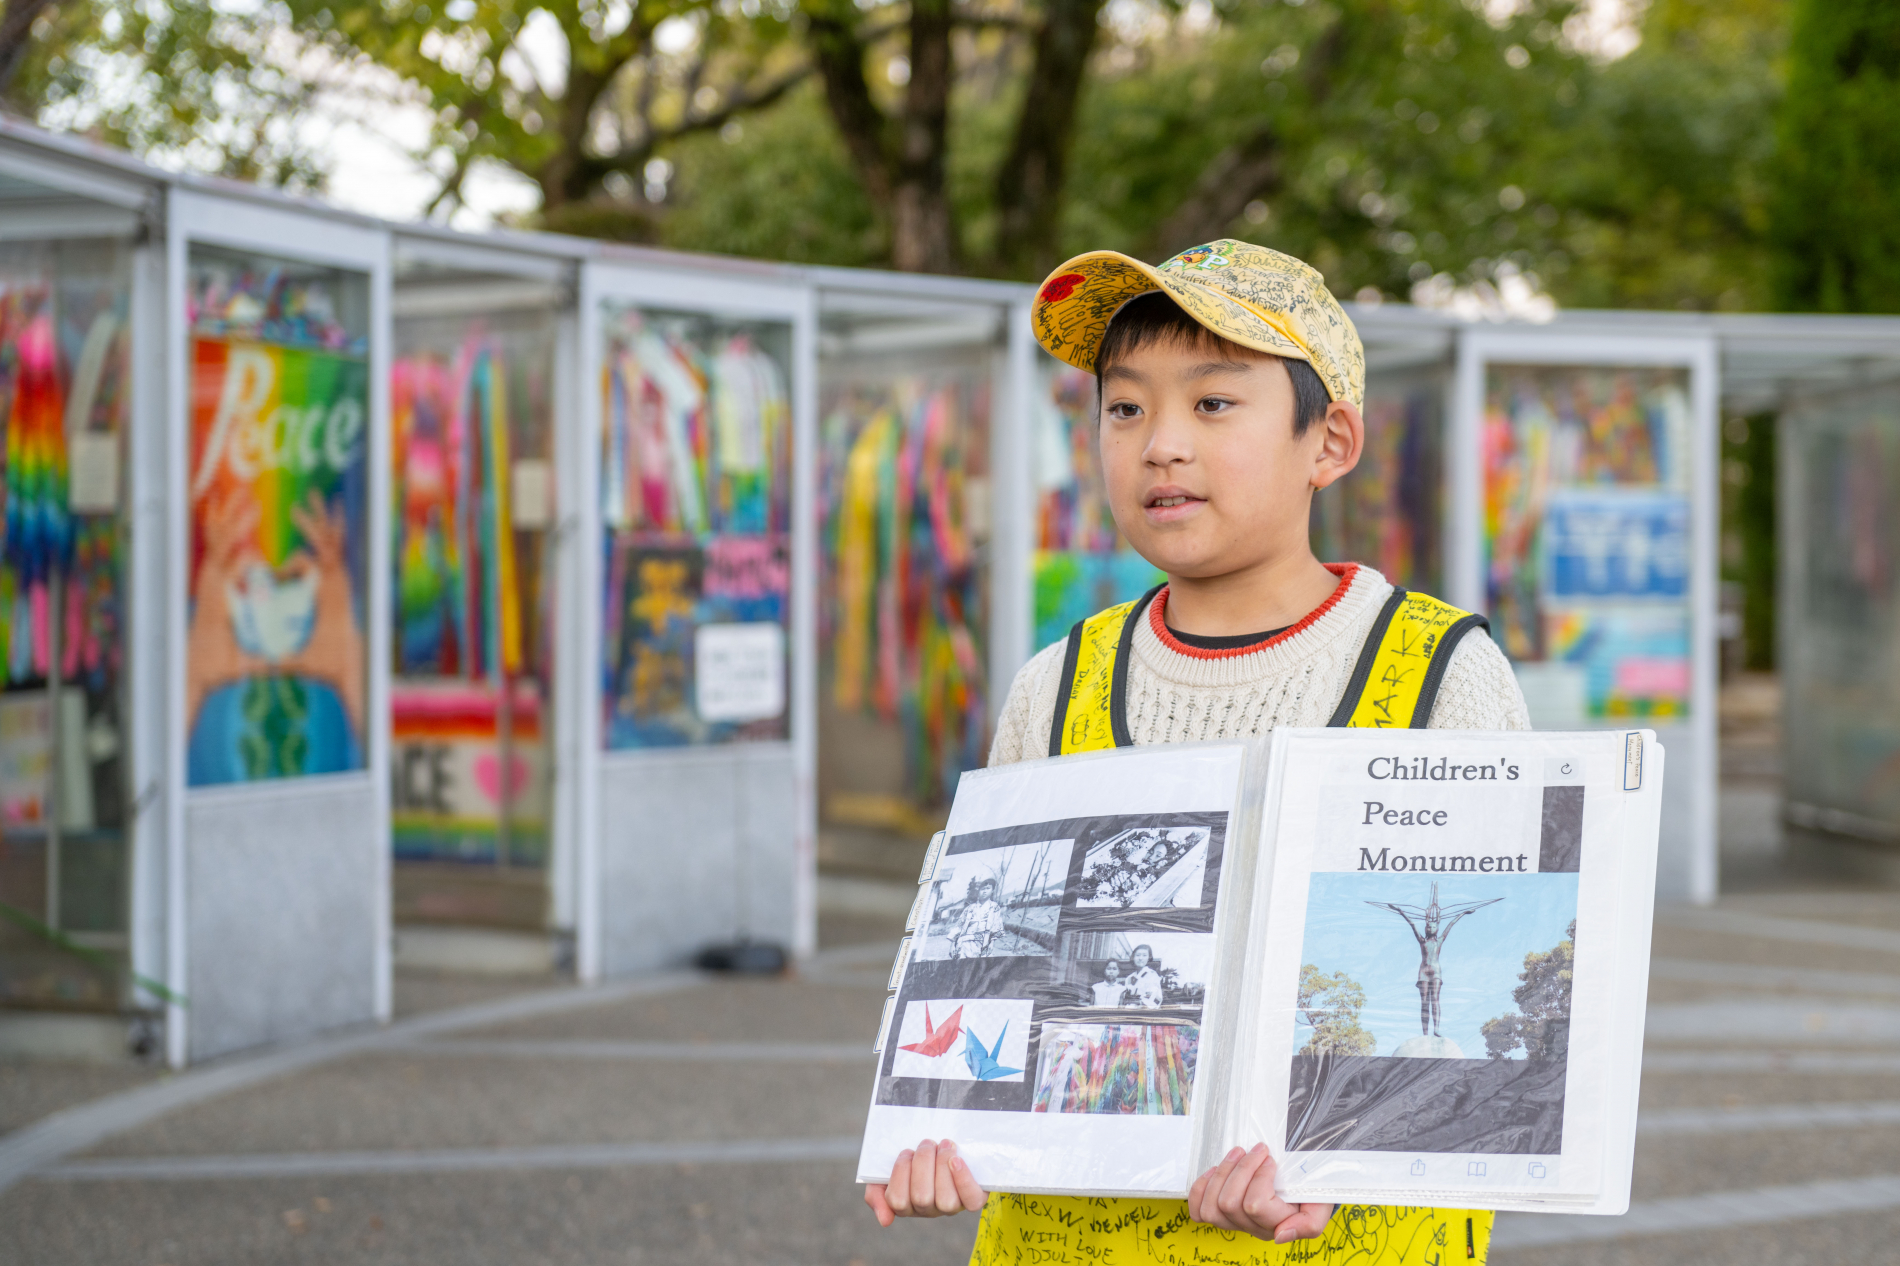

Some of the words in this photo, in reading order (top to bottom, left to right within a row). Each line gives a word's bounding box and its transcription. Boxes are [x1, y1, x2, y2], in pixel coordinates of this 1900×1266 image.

[191, 347, 362, 498] Peace
[1367, 756, 1519, 781] Children's
[1361, 801, 1448, 826] Peace
[1357, 847, 1528, 873] Monument
[1020, 1227, 1067, 1248] WITH
[1076, 1239, 1117, 1266] LOVE
